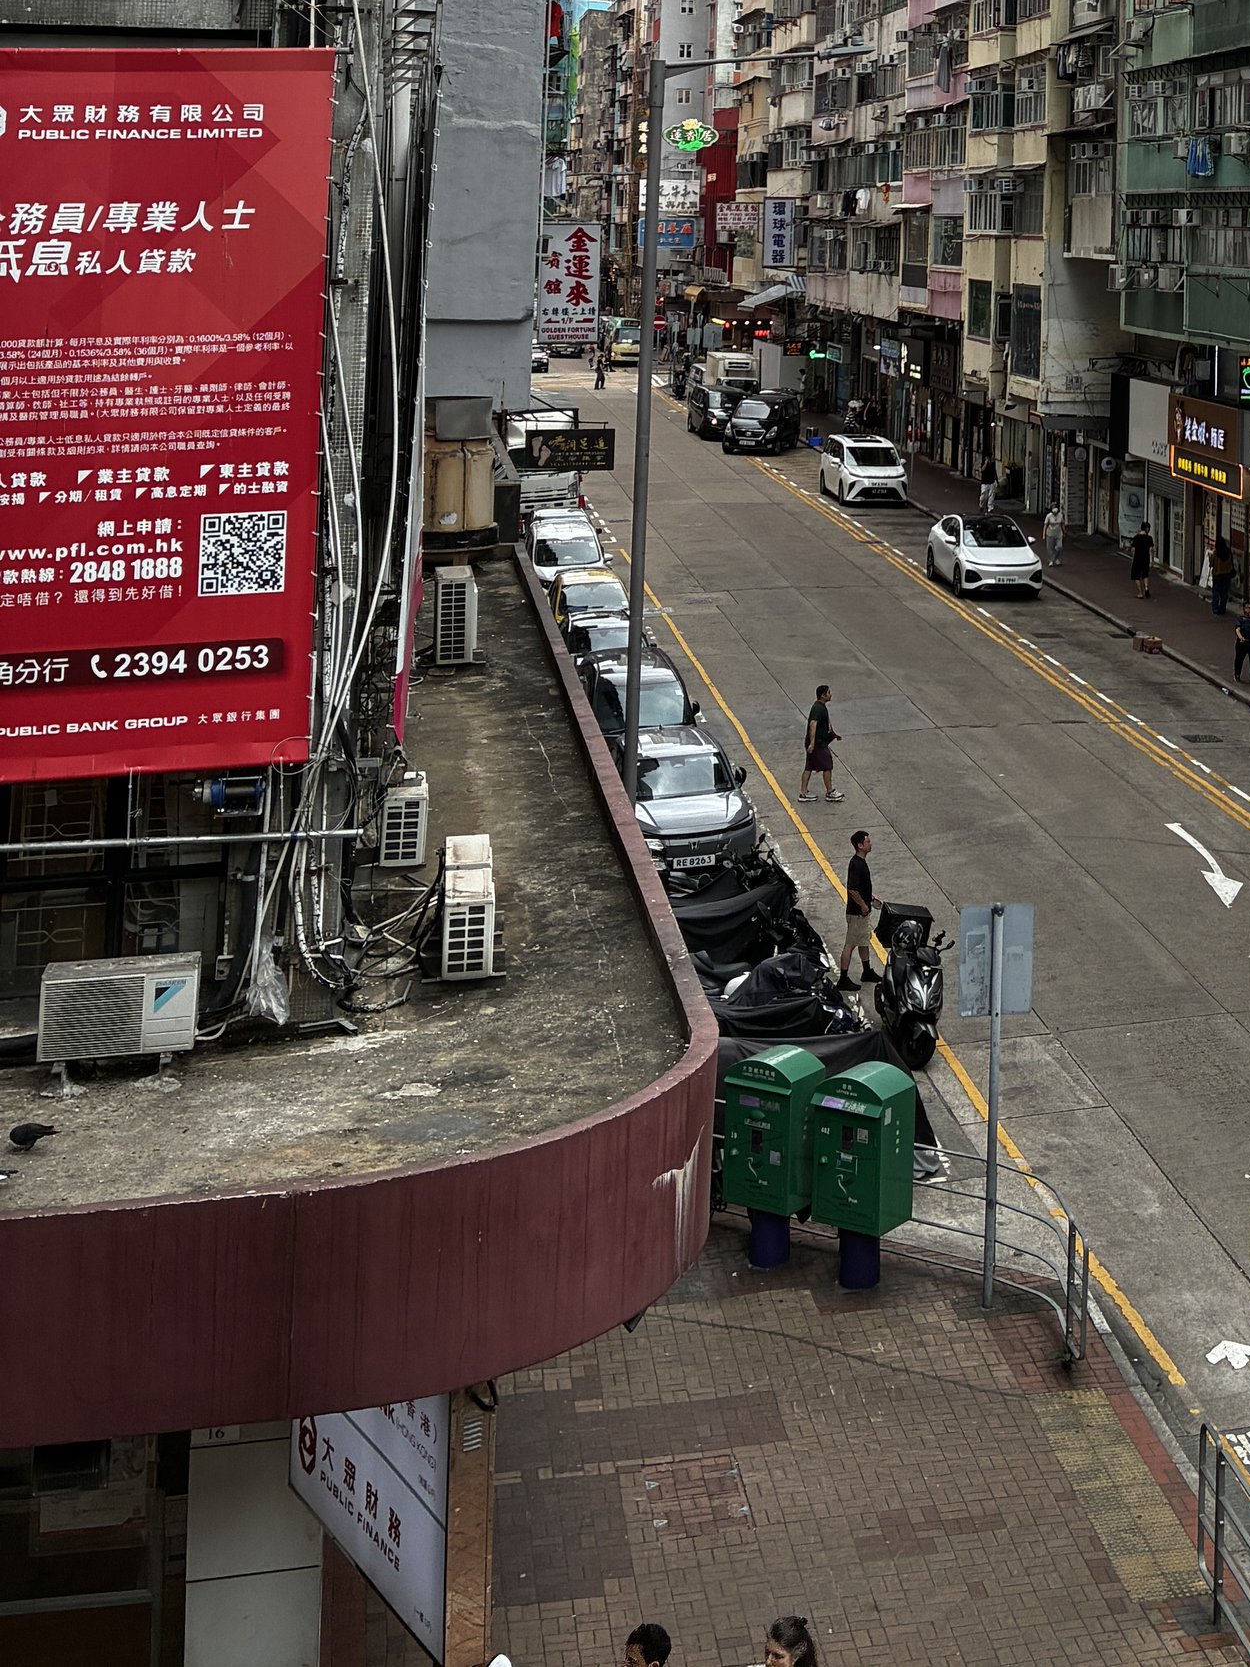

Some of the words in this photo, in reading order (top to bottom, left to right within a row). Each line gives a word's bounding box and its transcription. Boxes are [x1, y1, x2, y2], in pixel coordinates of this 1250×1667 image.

[19, 104, 264, 123] 大眾財務有限公司
[18, 129, 89, 140] PUBLIC
[95, 128, 181, 139] FINANCE
[187, 127, 263, 138] LIMITED
[0, 200, 256, 234] 務員/專業人士
[772, 201, 786, 264] 環球電器
[564, 227, 598, 307] 金運來
[97, 466, 170, 484] 業主貸款
[219, 461, 290, 478] 東主貸款
[151, 484, 206, 500] 高息定期
[233, 480, 289, 495] 的士融資
[0, 567, 64, 584] 款熱線:
[69, 560, 126, 584] 2848
[131, 557, 183, 580] 1888
[113, 650, 187, 677] 2394
[198, 644, 270, 672] 0253
[66, 719, 118, 734] BANK
[125, 715, 188, 730] GROUP
[198, 708, 280, 725] 大眾銀行集團
[676, 859, 688, 867] RE
[322, 1437, 401, 1548] 大眾財務
[320, 1470, 354, 1516] PUBLIC
[356, 1514, 400, 1572] FINANCE
